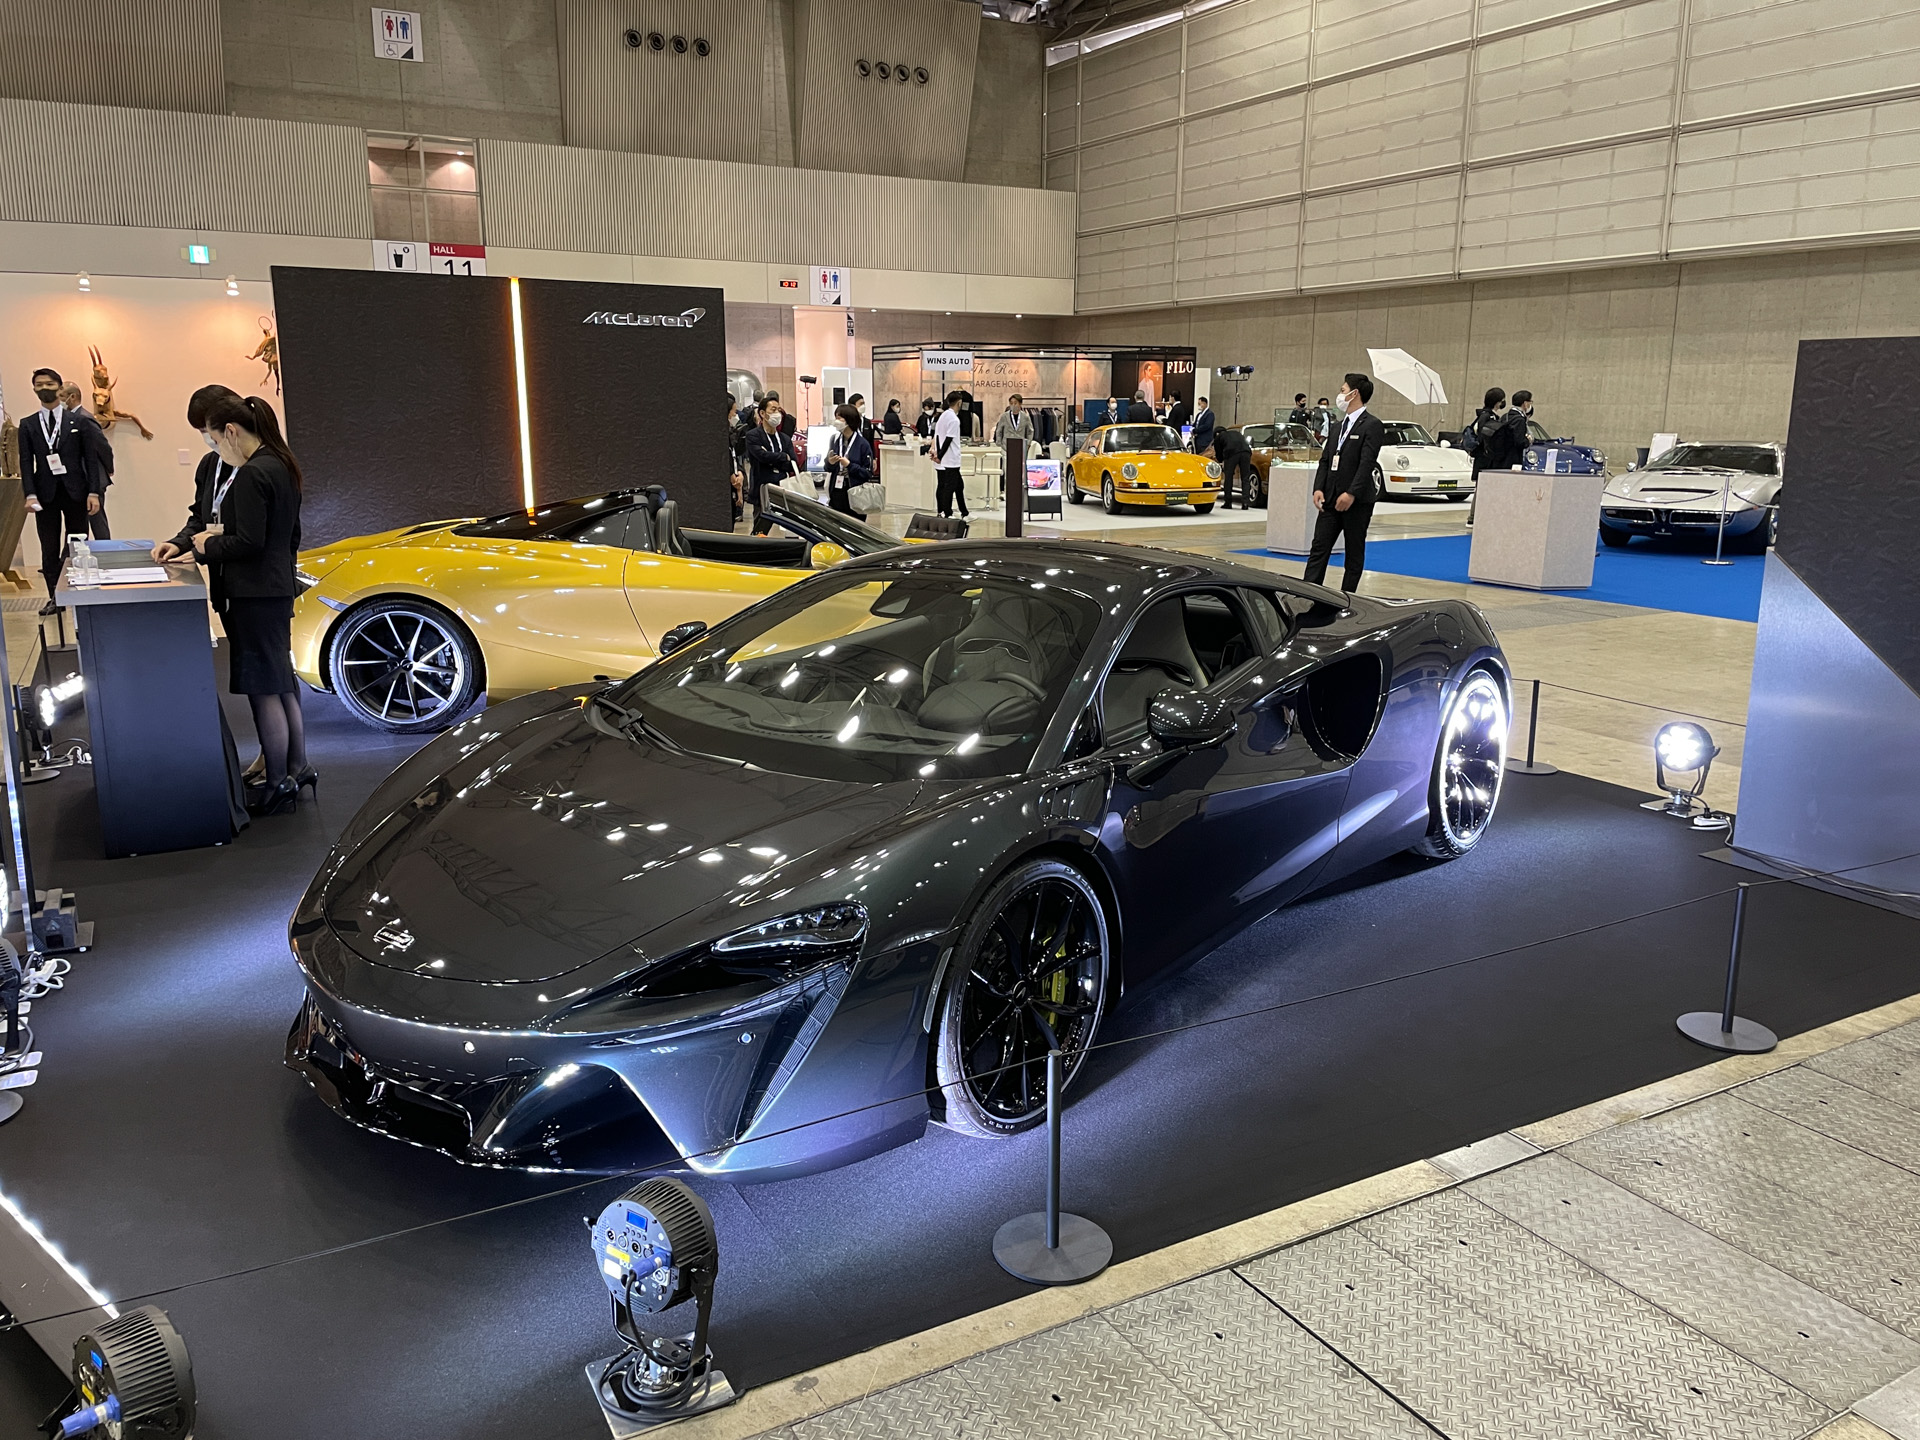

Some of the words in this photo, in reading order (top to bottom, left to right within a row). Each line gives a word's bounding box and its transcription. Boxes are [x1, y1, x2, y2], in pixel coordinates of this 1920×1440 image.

[433, 246, 456, 255] HALL
[444, 259, 472, 276] 11
[582, 311, 694, 328] McLaren
[926, 357, 947, 365] WINS
[1166, 360, 1194, 374] FILO
[972, 380, 1001, 388] ARAGE
[1002, 380, 1028, 388] HOUSE
